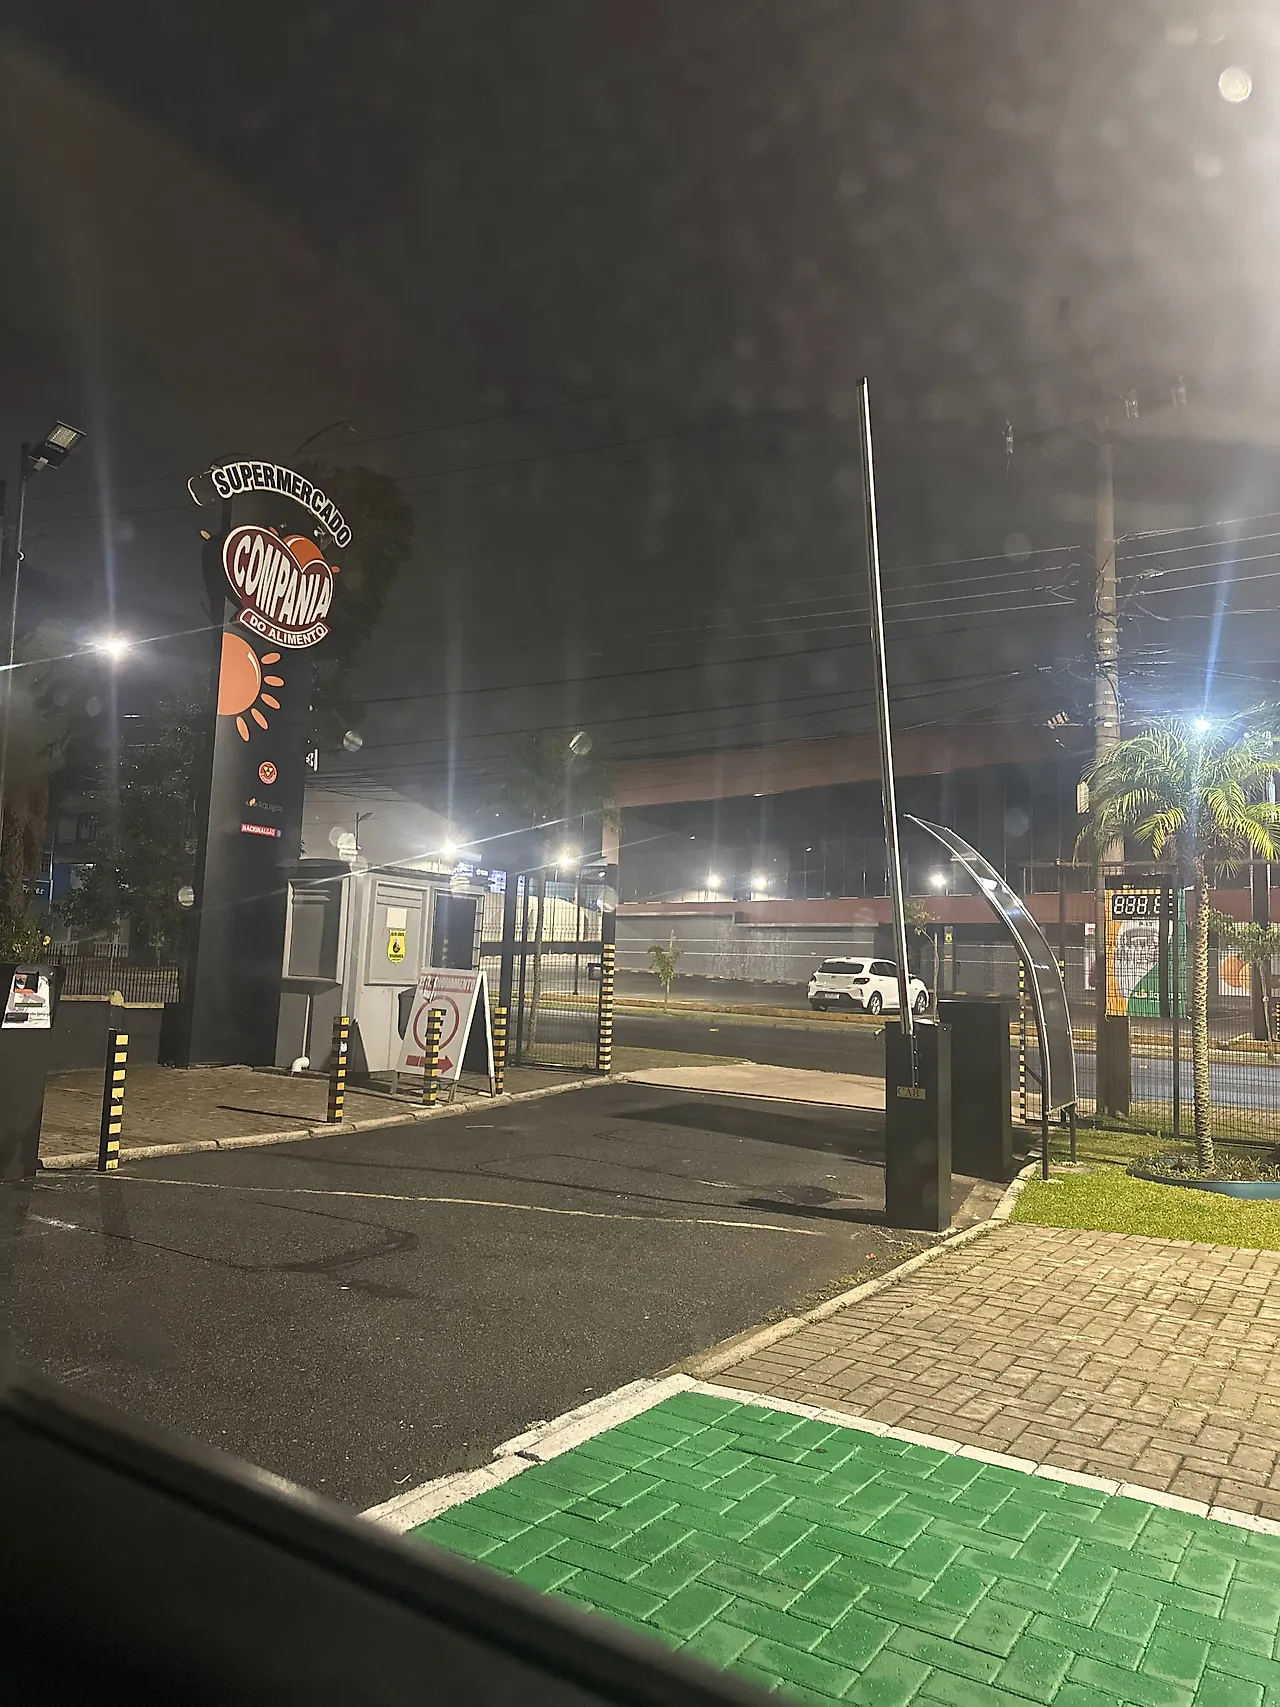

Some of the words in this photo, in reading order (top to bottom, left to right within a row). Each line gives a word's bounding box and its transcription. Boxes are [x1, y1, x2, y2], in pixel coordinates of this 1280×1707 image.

[211, 461, 352, 549] SUPERMERCADO
[233, 534, 331, 626] COMPANIA
[249, 614, 266, 633] DO
[268, 626, 327, 645] ALIMENTO
